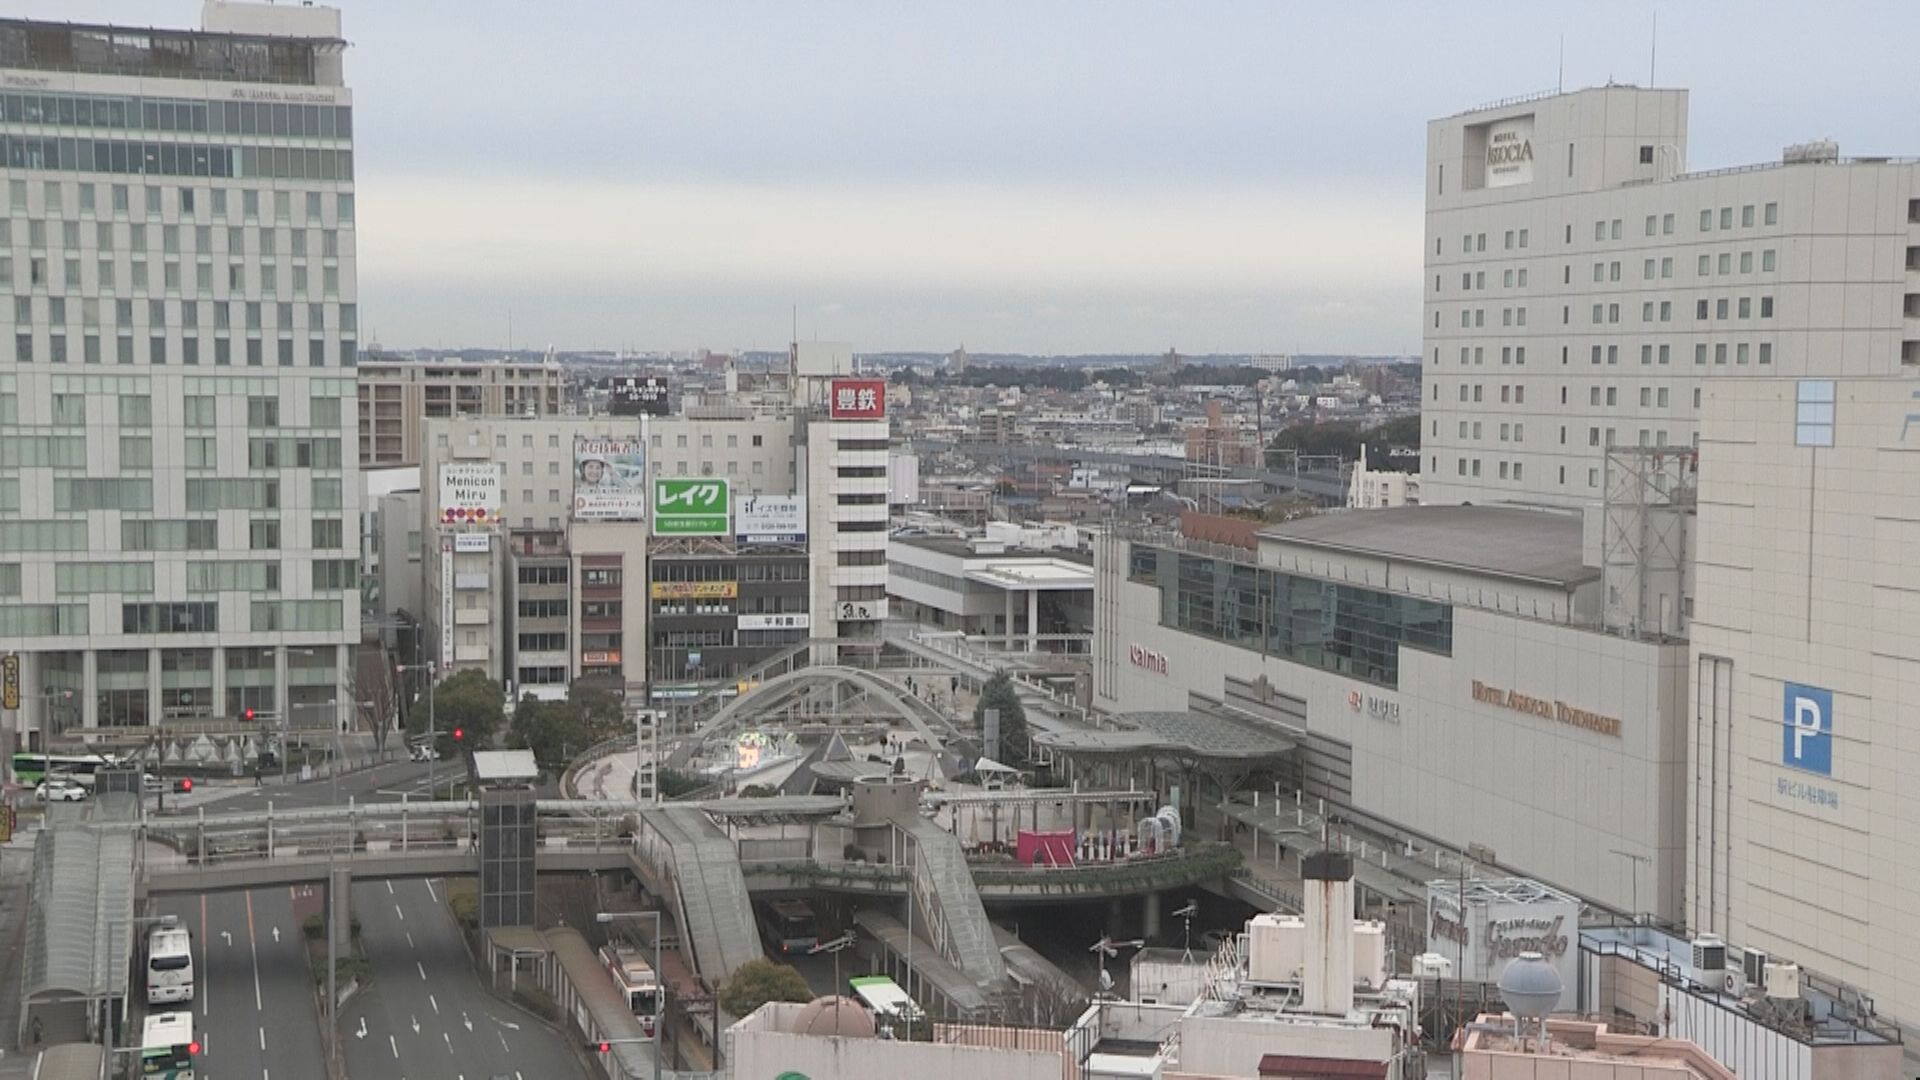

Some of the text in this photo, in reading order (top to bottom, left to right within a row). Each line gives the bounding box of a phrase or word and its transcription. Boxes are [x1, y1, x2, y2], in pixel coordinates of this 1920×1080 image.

[837, 387, 876, 411] 豊鉄
[446, 475, 495, 487] Menicon
[455, 489, 487, 501] Miru
[659, 484, 719, 506] レイク
[1128, 643, 1169, 677] Kalmia
[1472, 680, 1506, 707] HOTEL
[1793, 696, 1821, 760] P
